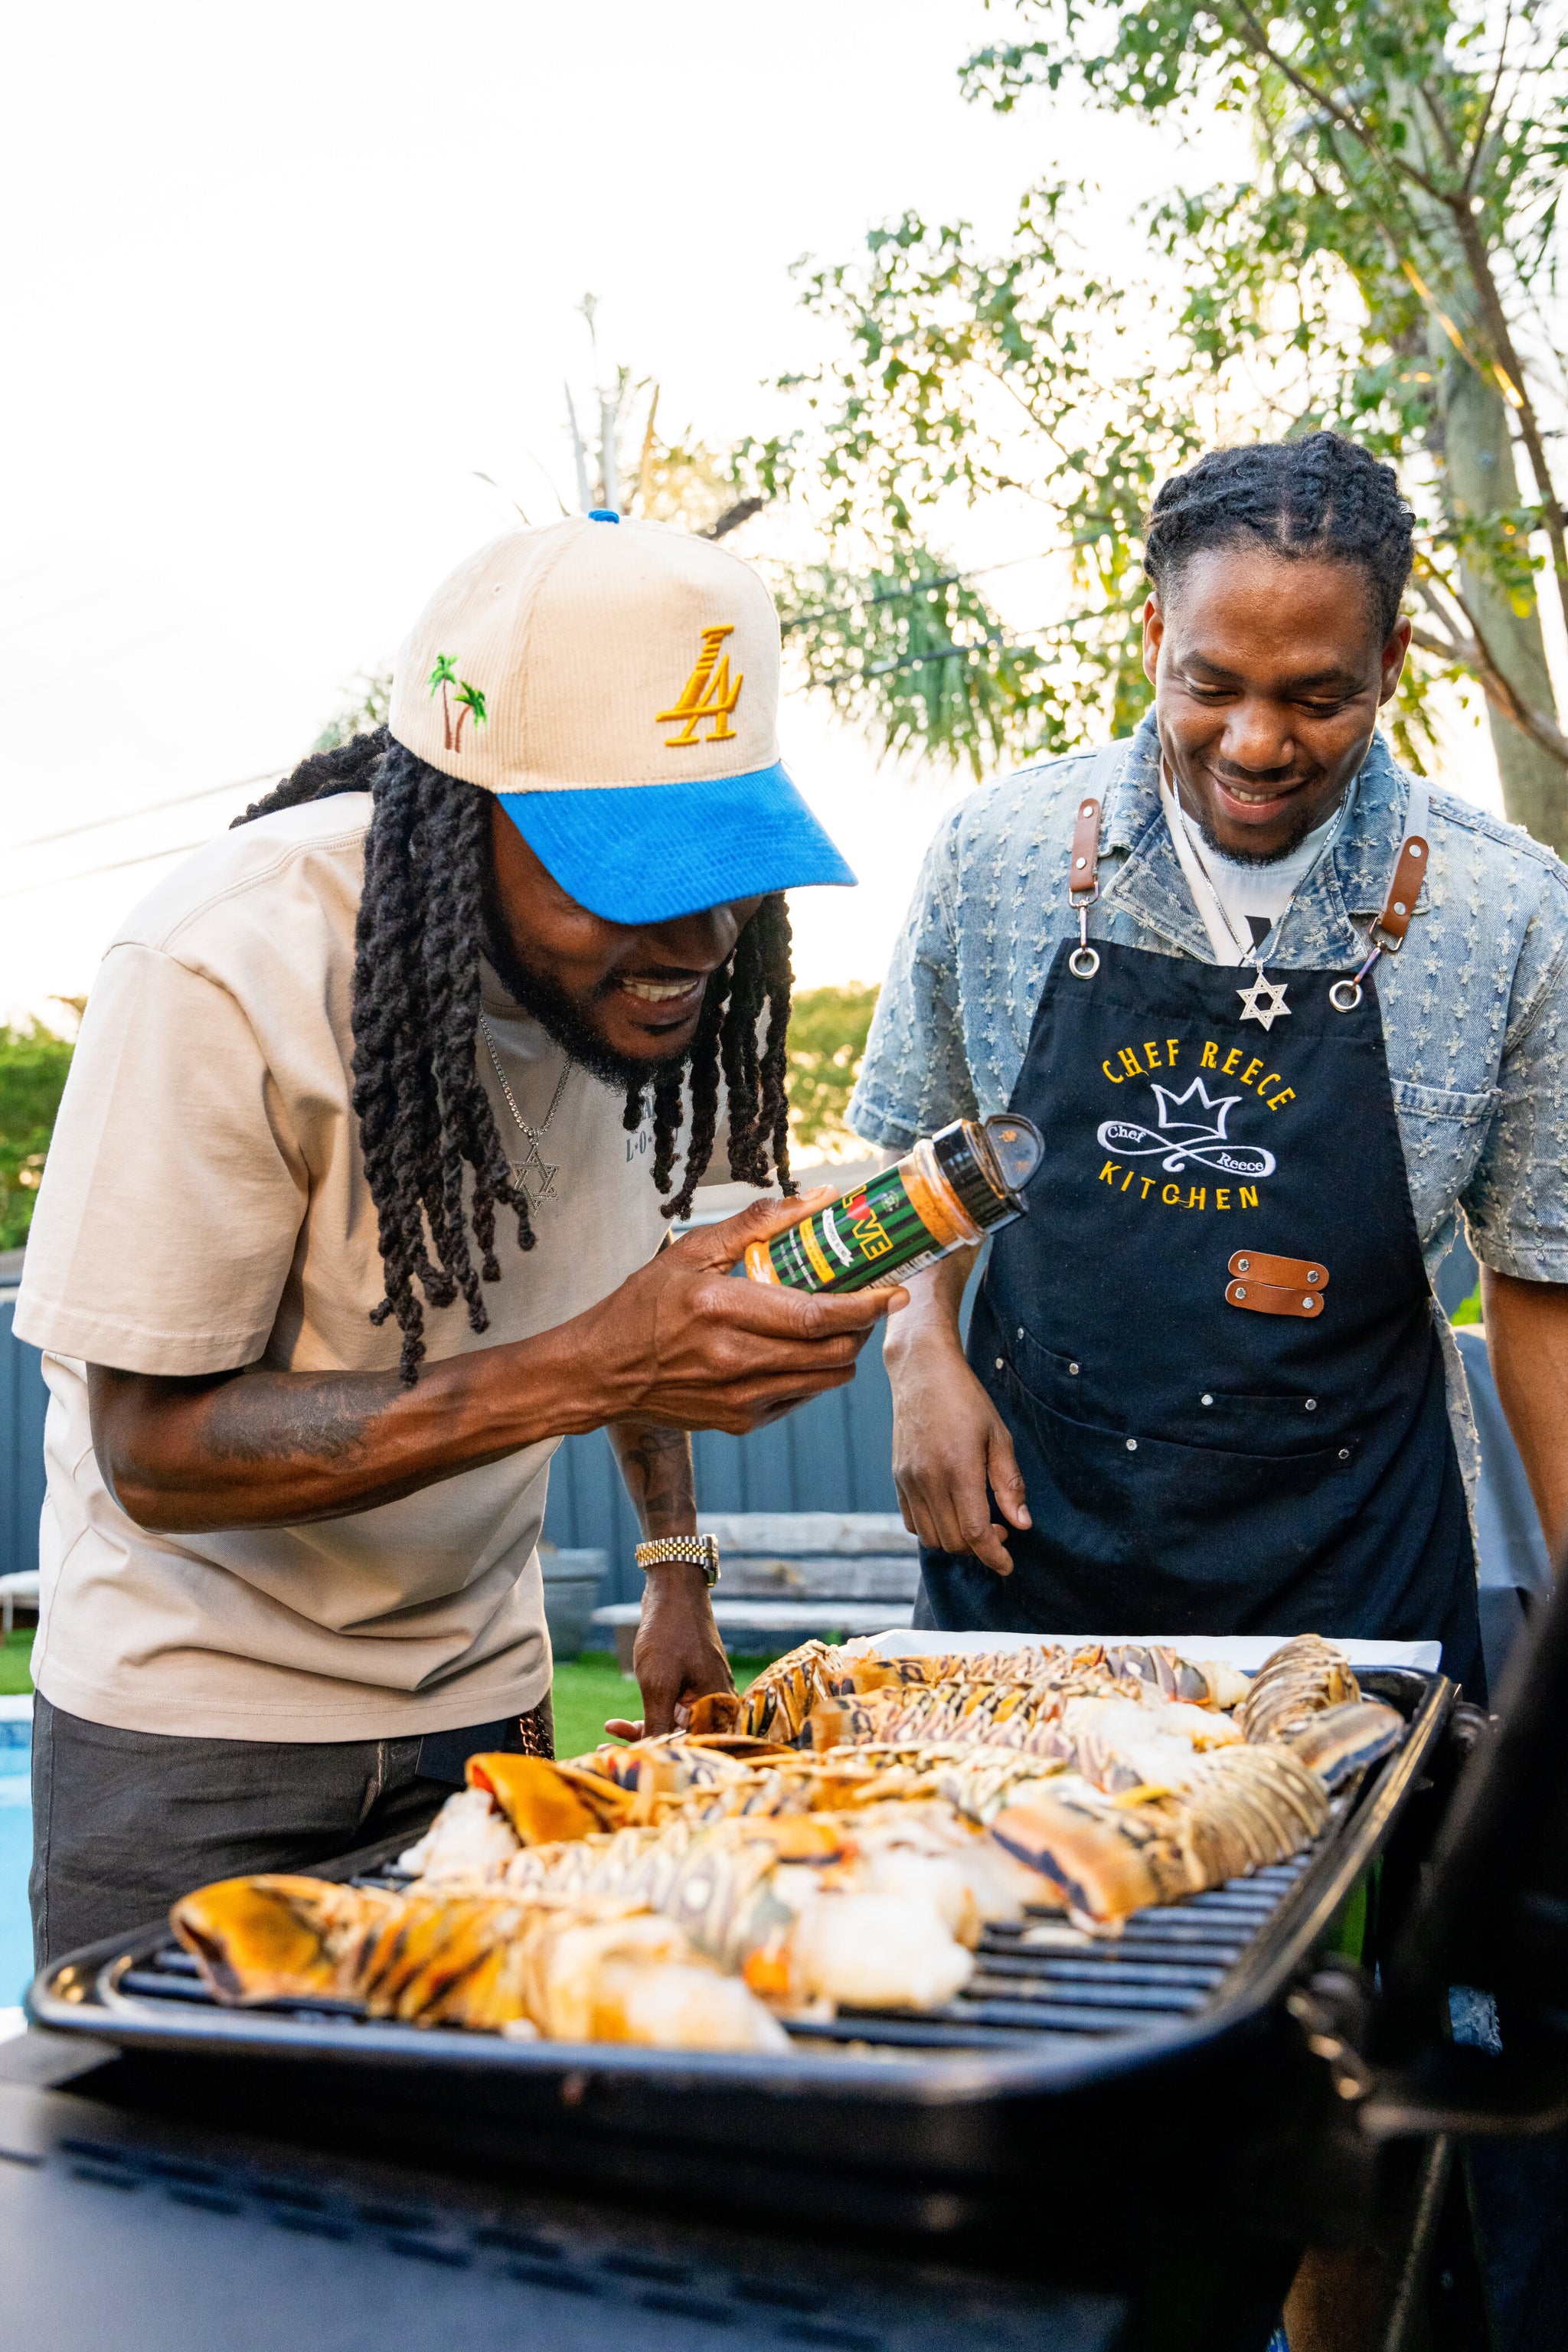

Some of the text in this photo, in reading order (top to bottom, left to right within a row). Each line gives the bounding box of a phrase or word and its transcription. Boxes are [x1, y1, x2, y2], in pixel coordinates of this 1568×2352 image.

[655, 623, 743, 747] LA
[1102, 1039, 1296, 1111] CHEF REECE
[1107, 1125, 1146, 1143] Chef
[1098, 1161, 1259, 1210] KITCHEN
[1217, 1152, 1264, 1171] Reece
